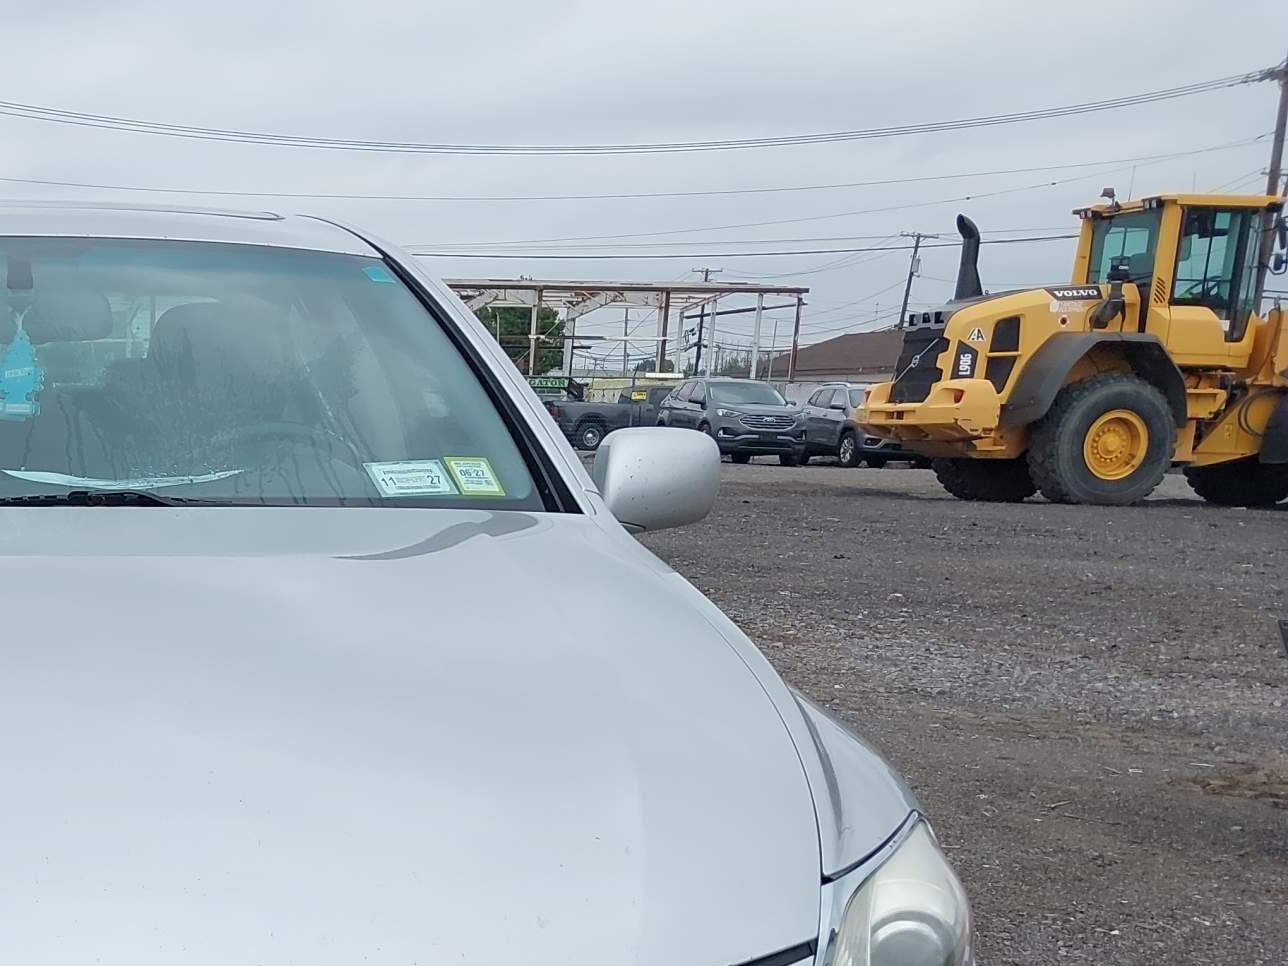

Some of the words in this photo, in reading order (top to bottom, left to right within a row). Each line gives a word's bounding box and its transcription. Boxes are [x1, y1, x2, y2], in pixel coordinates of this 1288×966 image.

[1053, 289, 1098, 297] VOLVO
[958, 353, 972, 375] L90G
[426, 475, 441, 485] 27
